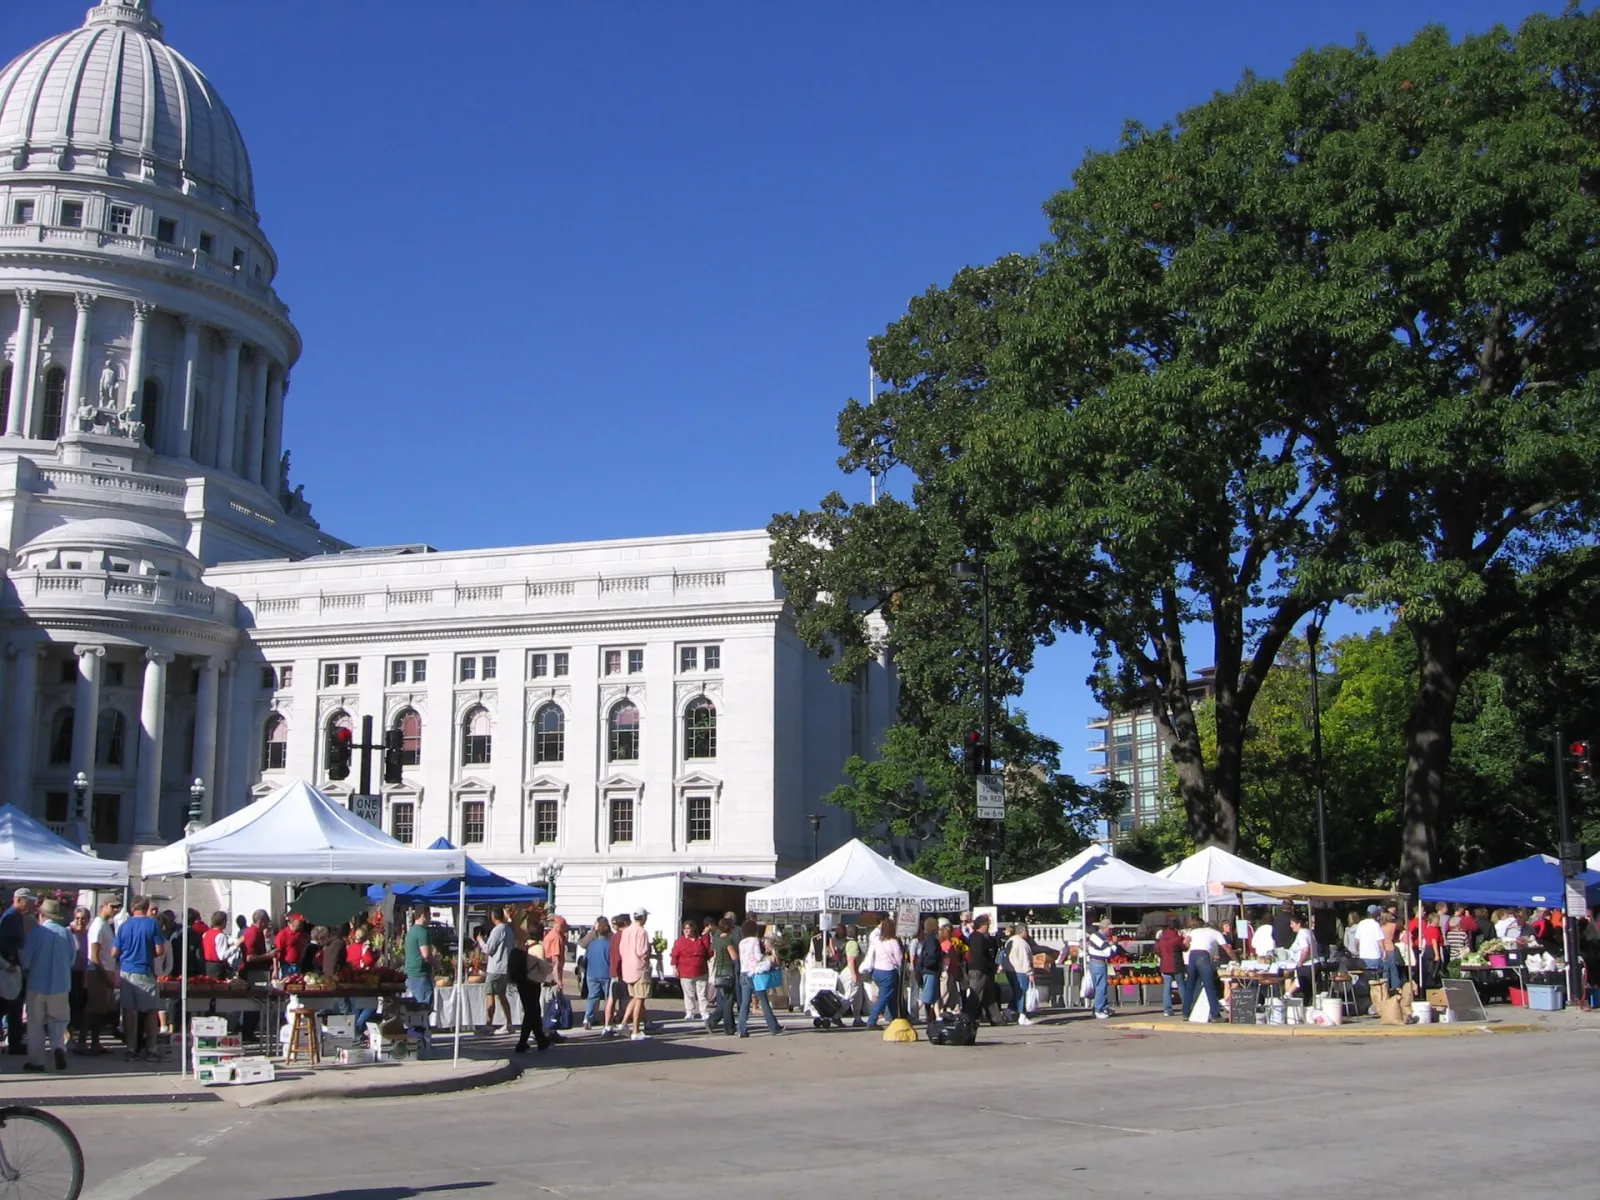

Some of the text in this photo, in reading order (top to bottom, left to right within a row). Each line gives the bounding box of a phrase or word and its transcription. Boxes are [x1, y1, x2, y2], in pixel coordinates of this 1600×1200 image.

[984, 776, 997, 785] NO
[356, 798, 378, 810] ONE
[990, 795, 1003, 803] RED
[356, 810, 378, 820] WAY
[748, 896, 819, 911] GOLDEN DREAMS OSTRICH
[828, 895, 868, 911] GOLDEN
[920, 897, 961, 912] OSTRICH
